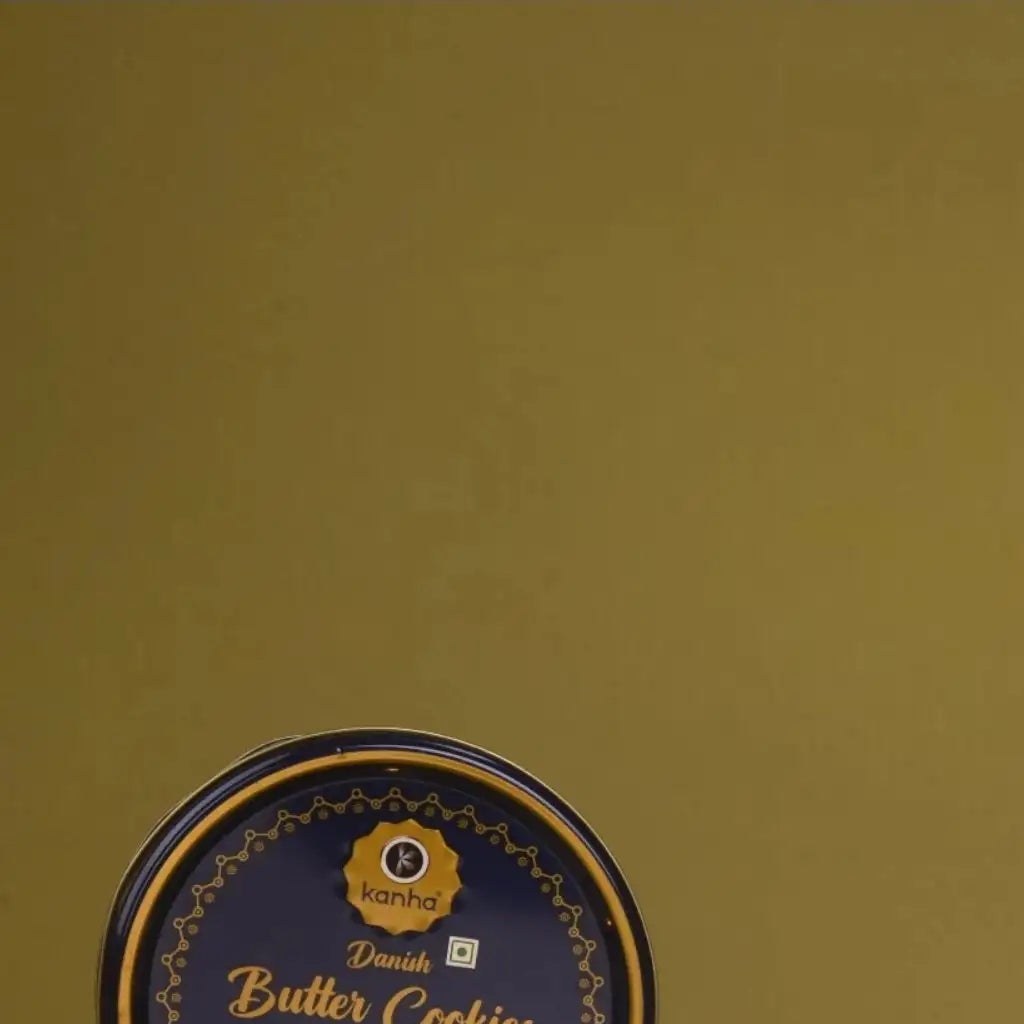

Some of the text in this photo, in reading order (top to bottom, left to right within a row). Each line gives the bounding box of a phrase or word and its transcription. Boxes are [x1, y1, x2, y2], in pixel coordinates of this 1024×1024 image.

[361, 881, 438, 911] kanha
[346, 940, 432, 975] Danish
[227, 966, 372, 1024] Butter
